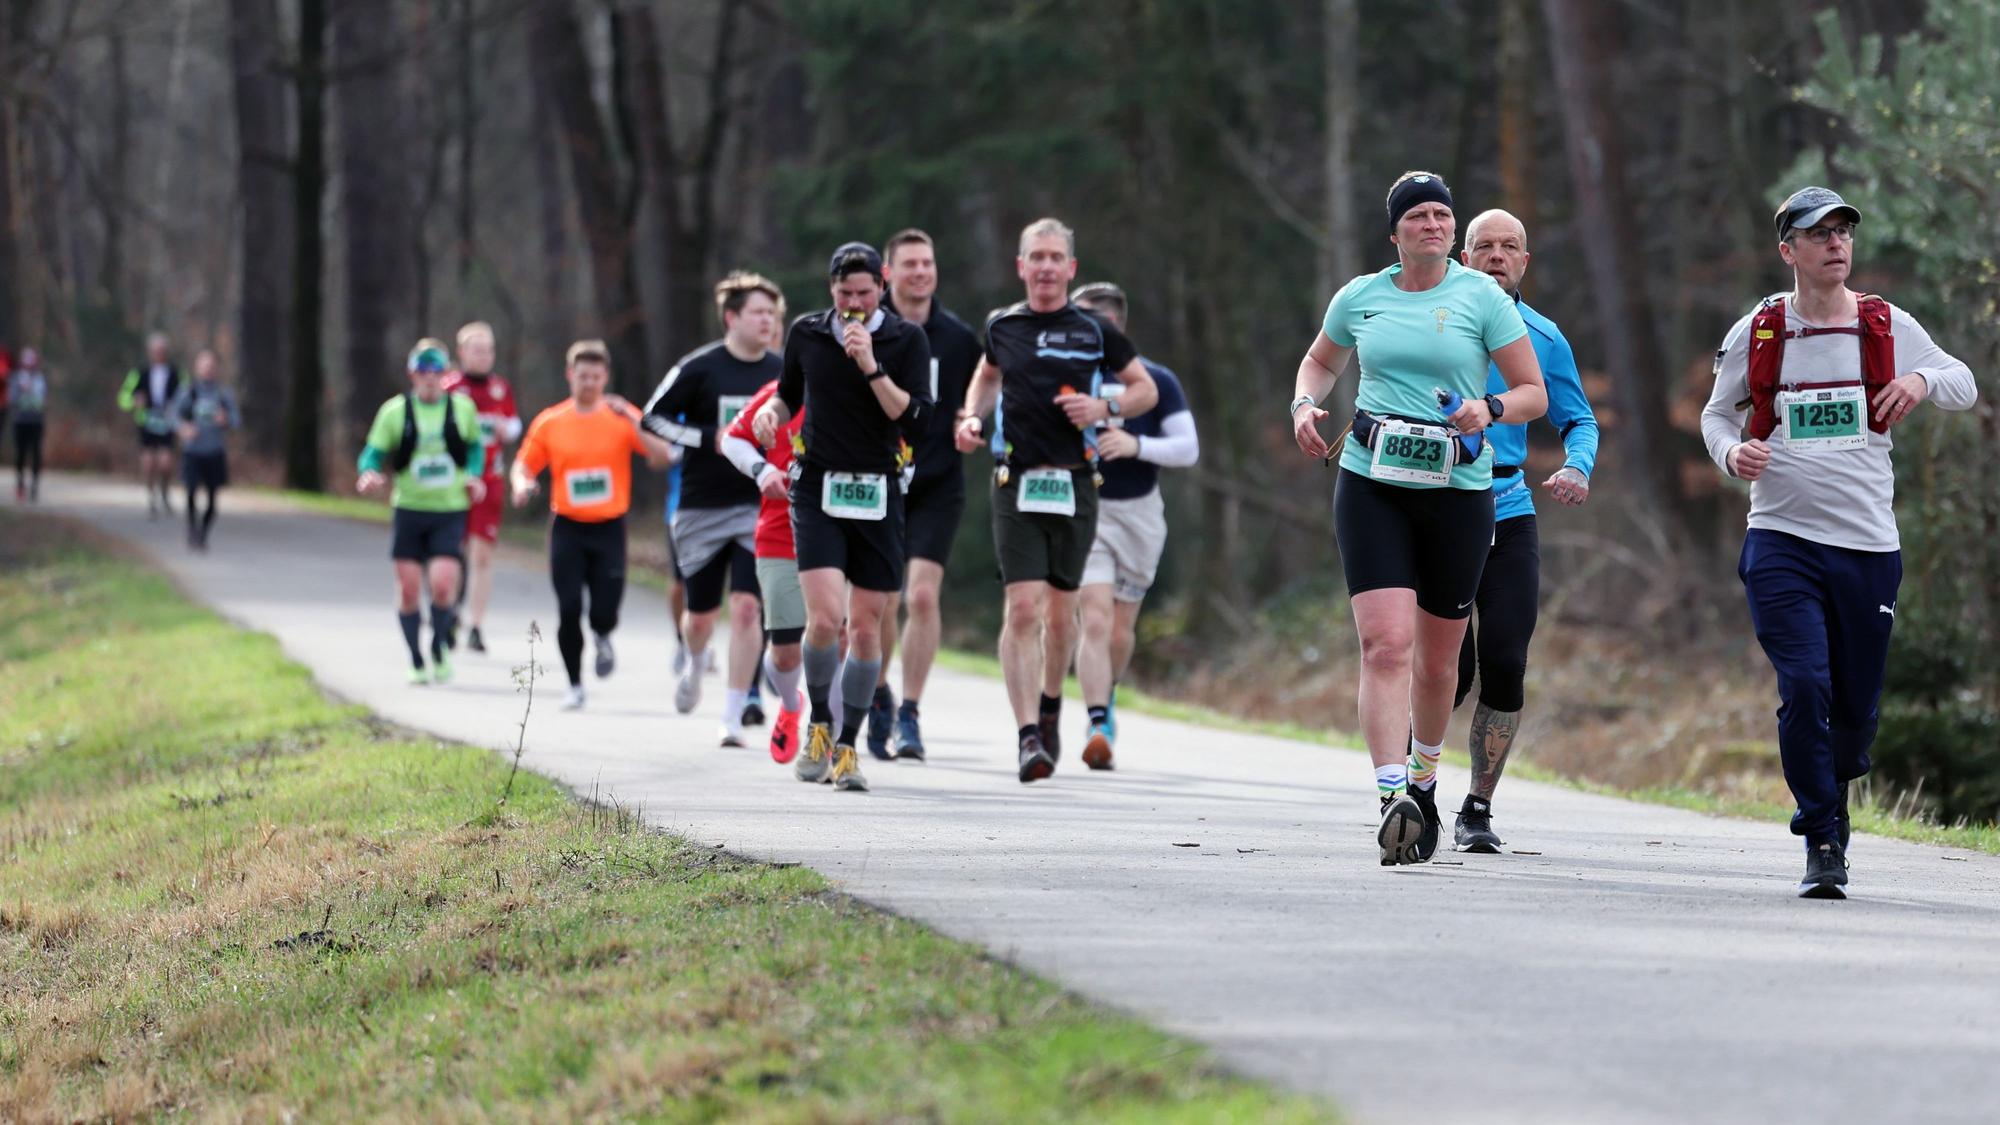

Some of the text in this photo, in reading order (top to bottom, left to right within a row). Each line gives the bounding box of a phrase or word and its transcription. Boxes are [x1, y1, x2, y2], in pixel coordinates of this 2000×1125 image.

[1794, 403, 1854, 427] 1253
[1385, 435, 1442, 462] 8823
[834, 482, 877, 501] 1567
[1028, 479, 1070, 497] 2404
